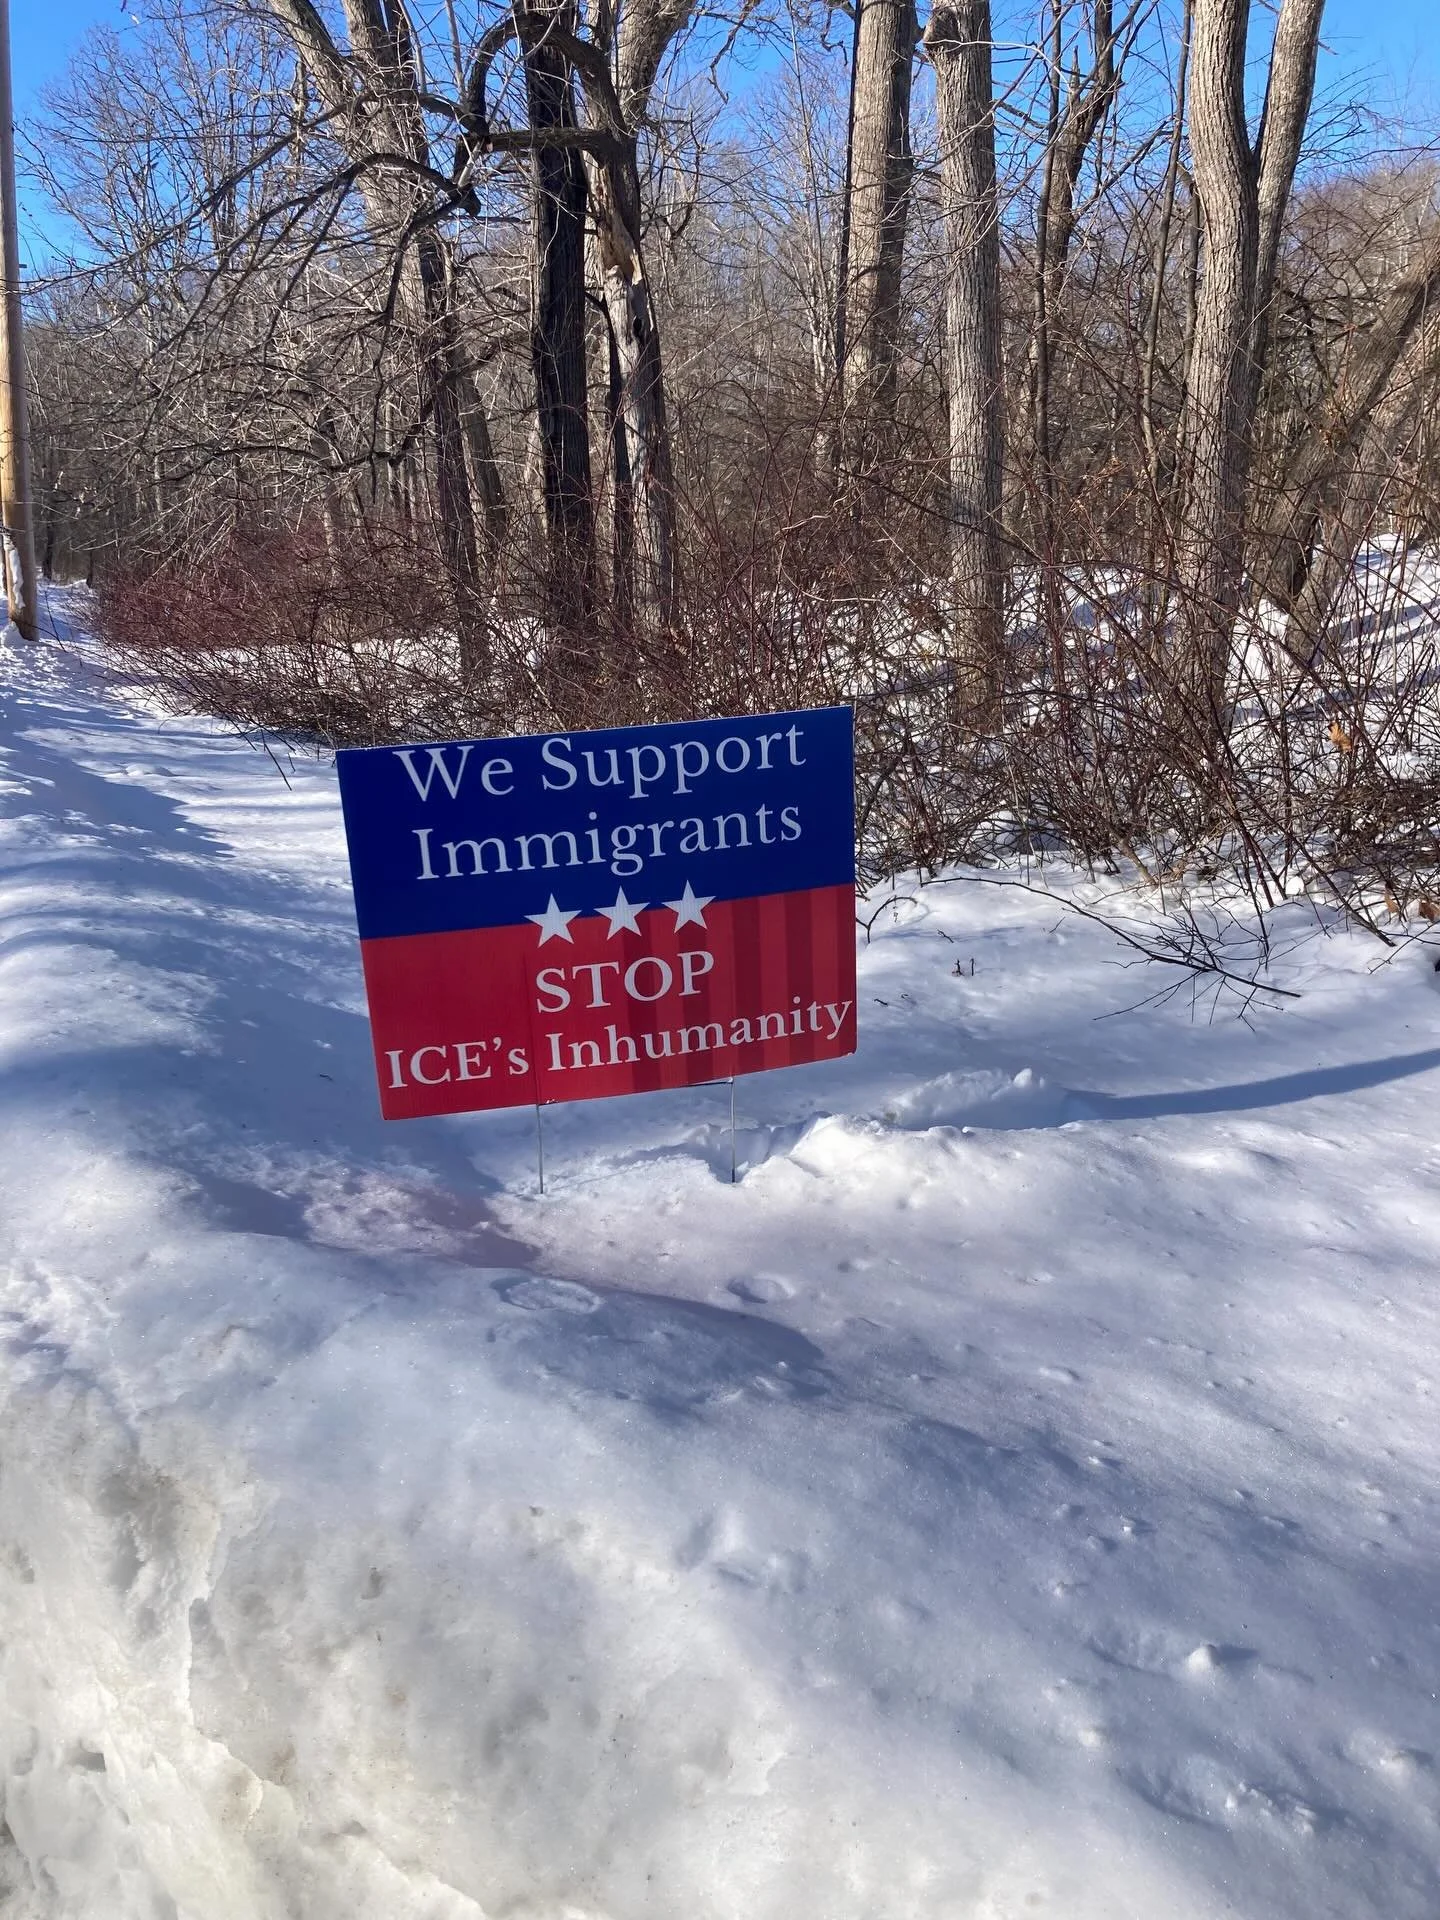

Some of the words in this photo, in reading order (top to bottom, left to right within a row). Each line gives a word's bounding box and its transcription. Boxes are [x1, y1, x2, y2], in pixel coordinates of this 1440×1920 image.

[393, 745, 515, 802] We
[542, 724, 807, 799] Support
[412, 804, 803, 880] Immigrants
[536, 950, 715, 1014] STOP
[385, 1036, 530, 1089] ICE's
[546, 996, 854, 1072] Inhumanity
